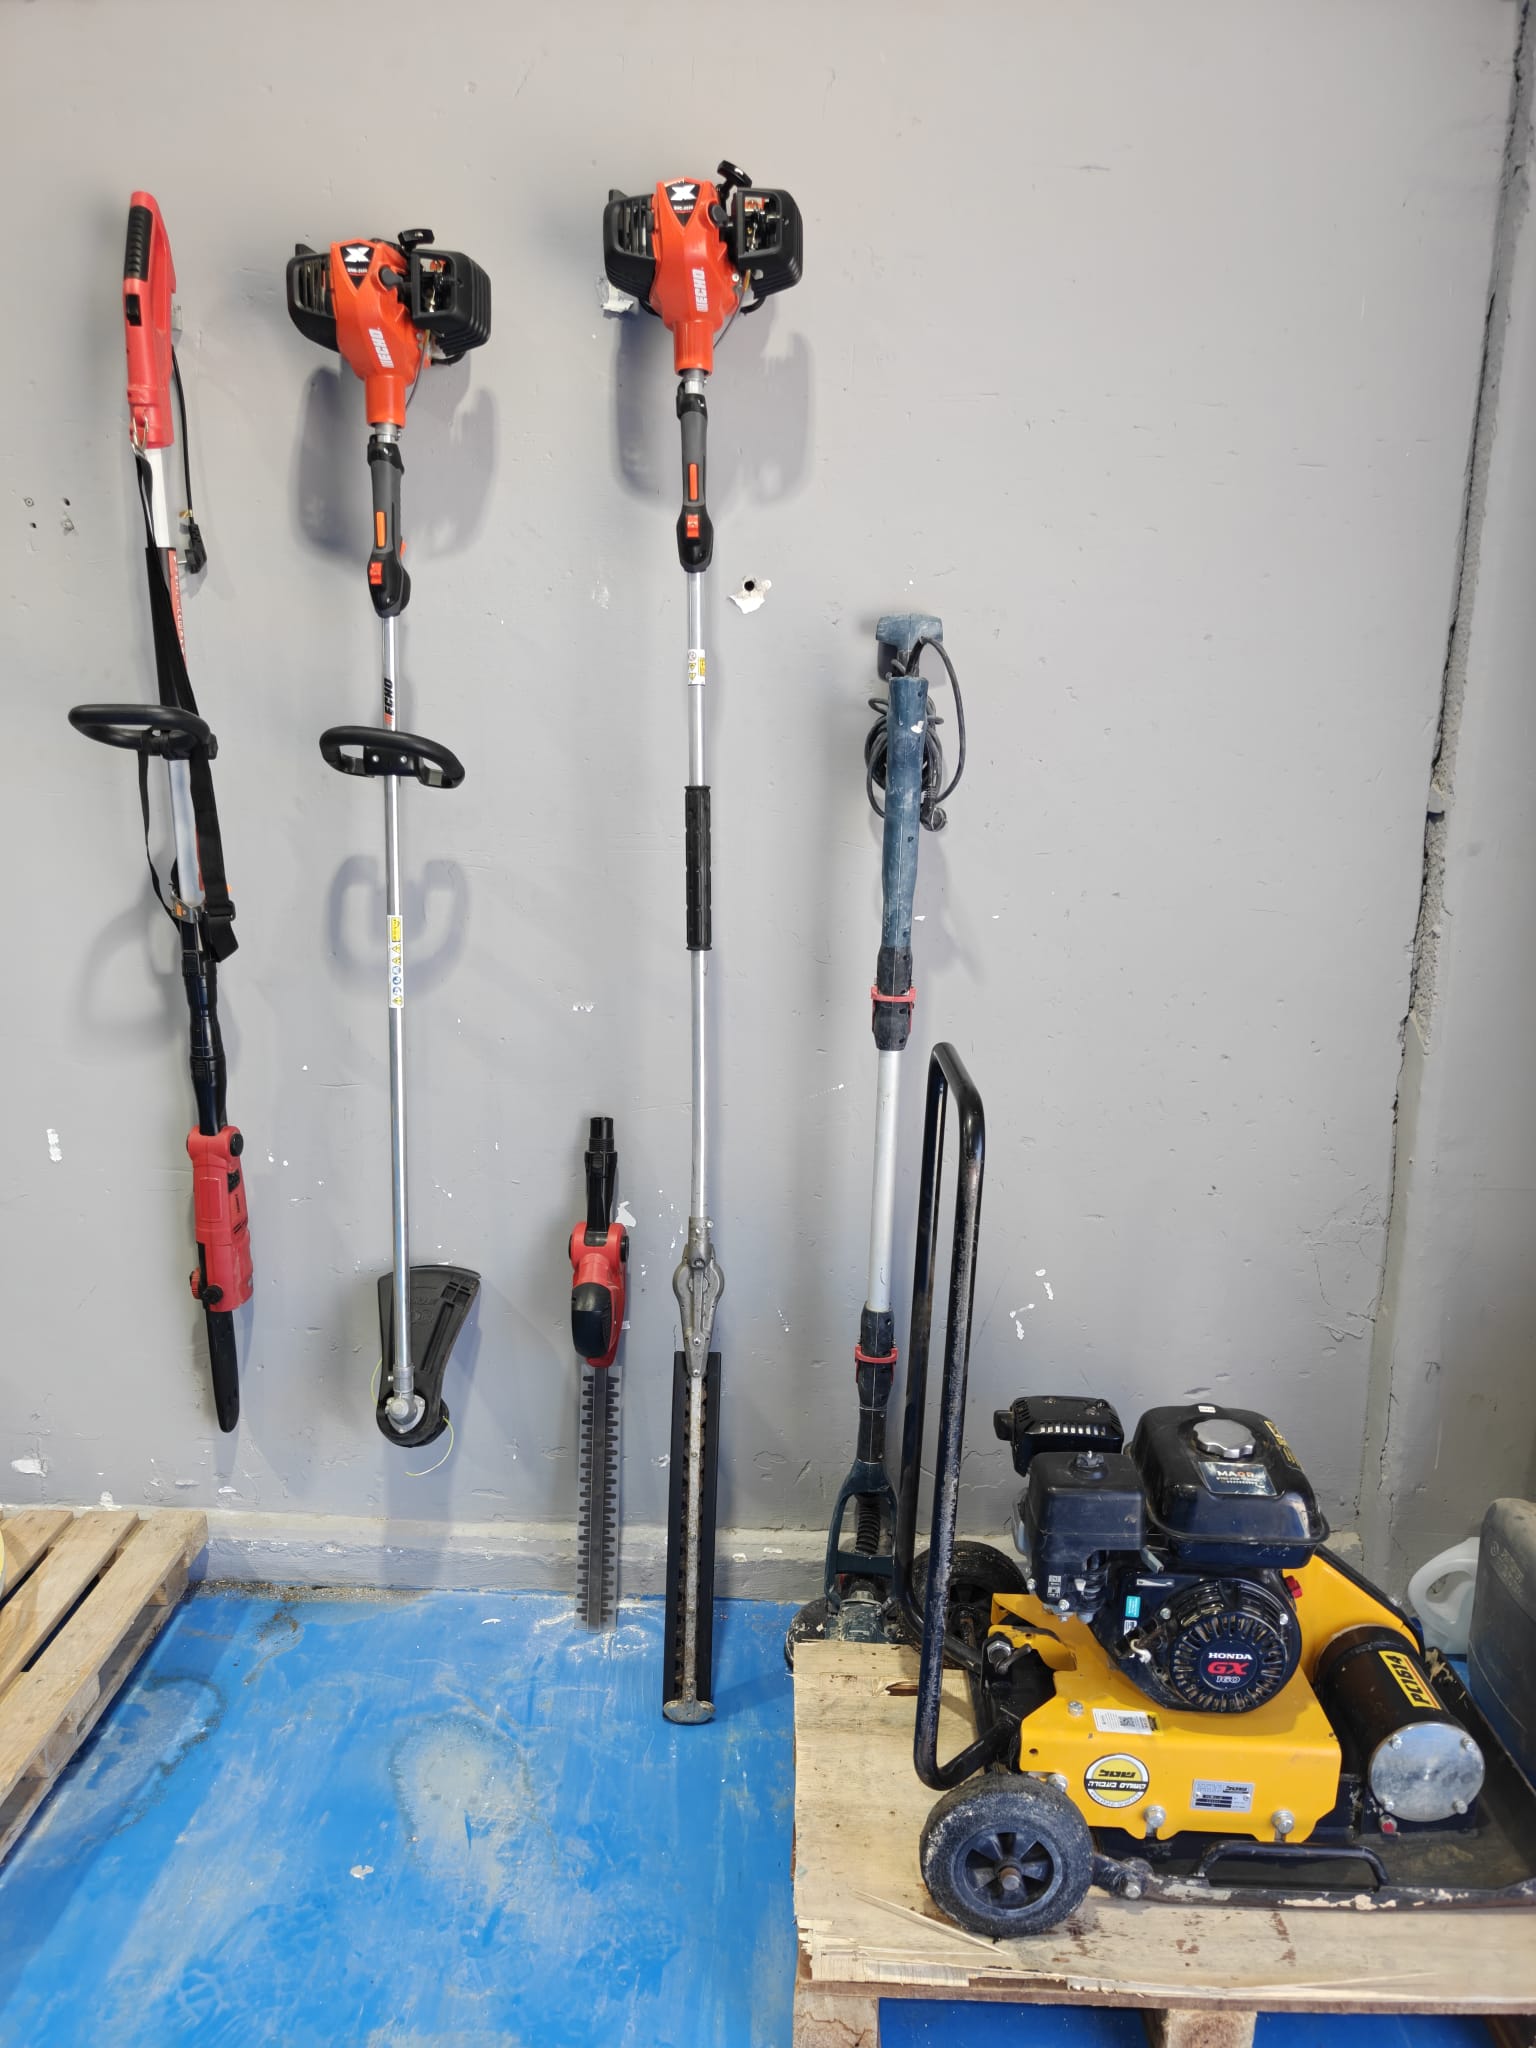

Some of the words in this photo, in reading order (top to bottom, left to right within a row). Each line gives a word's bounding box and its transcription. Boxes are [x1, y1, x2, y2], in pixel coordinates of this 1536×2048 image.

[383, 677, 393, 715] ECHO
[1208, 1652, 1253, 1661] HONDA
[1207, 1661, 1250, 1675] GX
[1216, 1675, 1241, 1684] 160
[1384, 1655, 1433, 1706] PC1614
